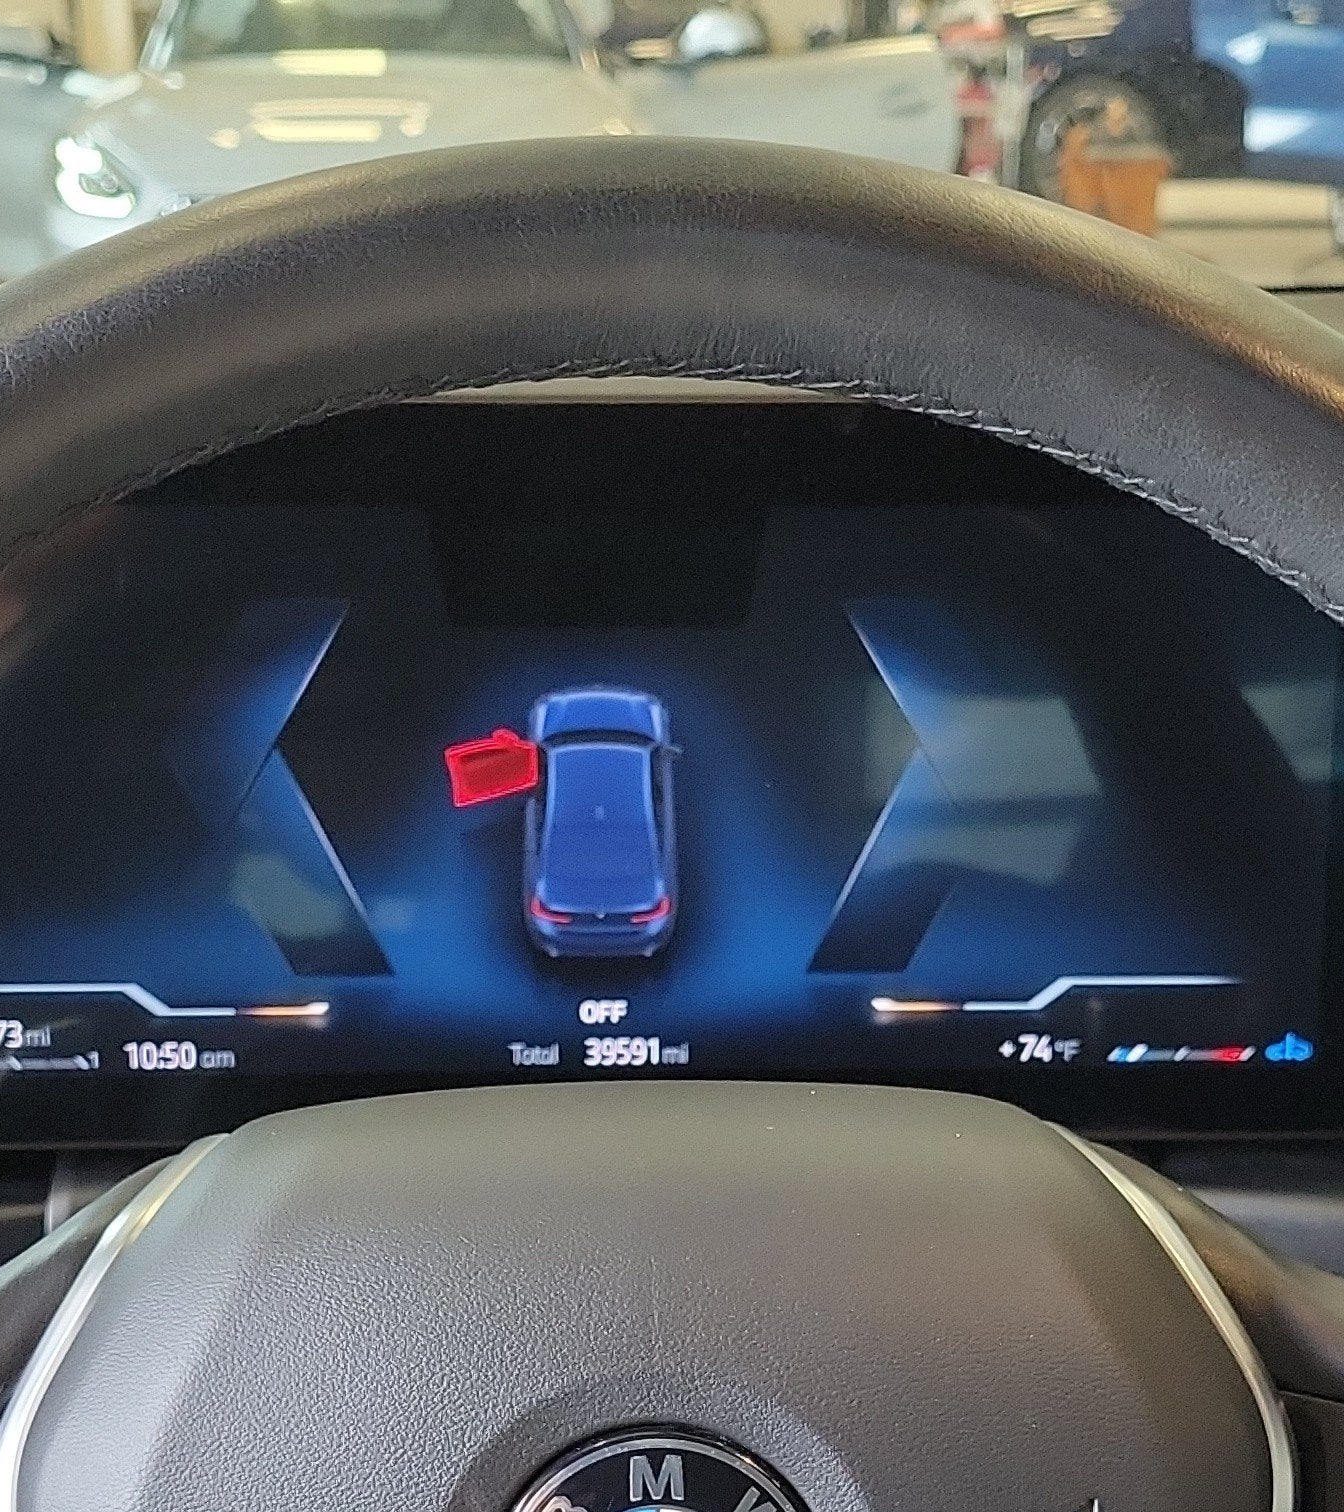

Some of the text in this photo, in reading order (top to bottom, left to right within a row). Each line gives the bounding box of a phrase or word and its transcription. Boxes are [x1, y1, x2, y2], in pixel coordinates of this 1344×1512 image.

[579, 999, 629, 1024] OFF
[122, 1041, 197, 1070] 10:50
[507, 1041, 560, 1067] Total
